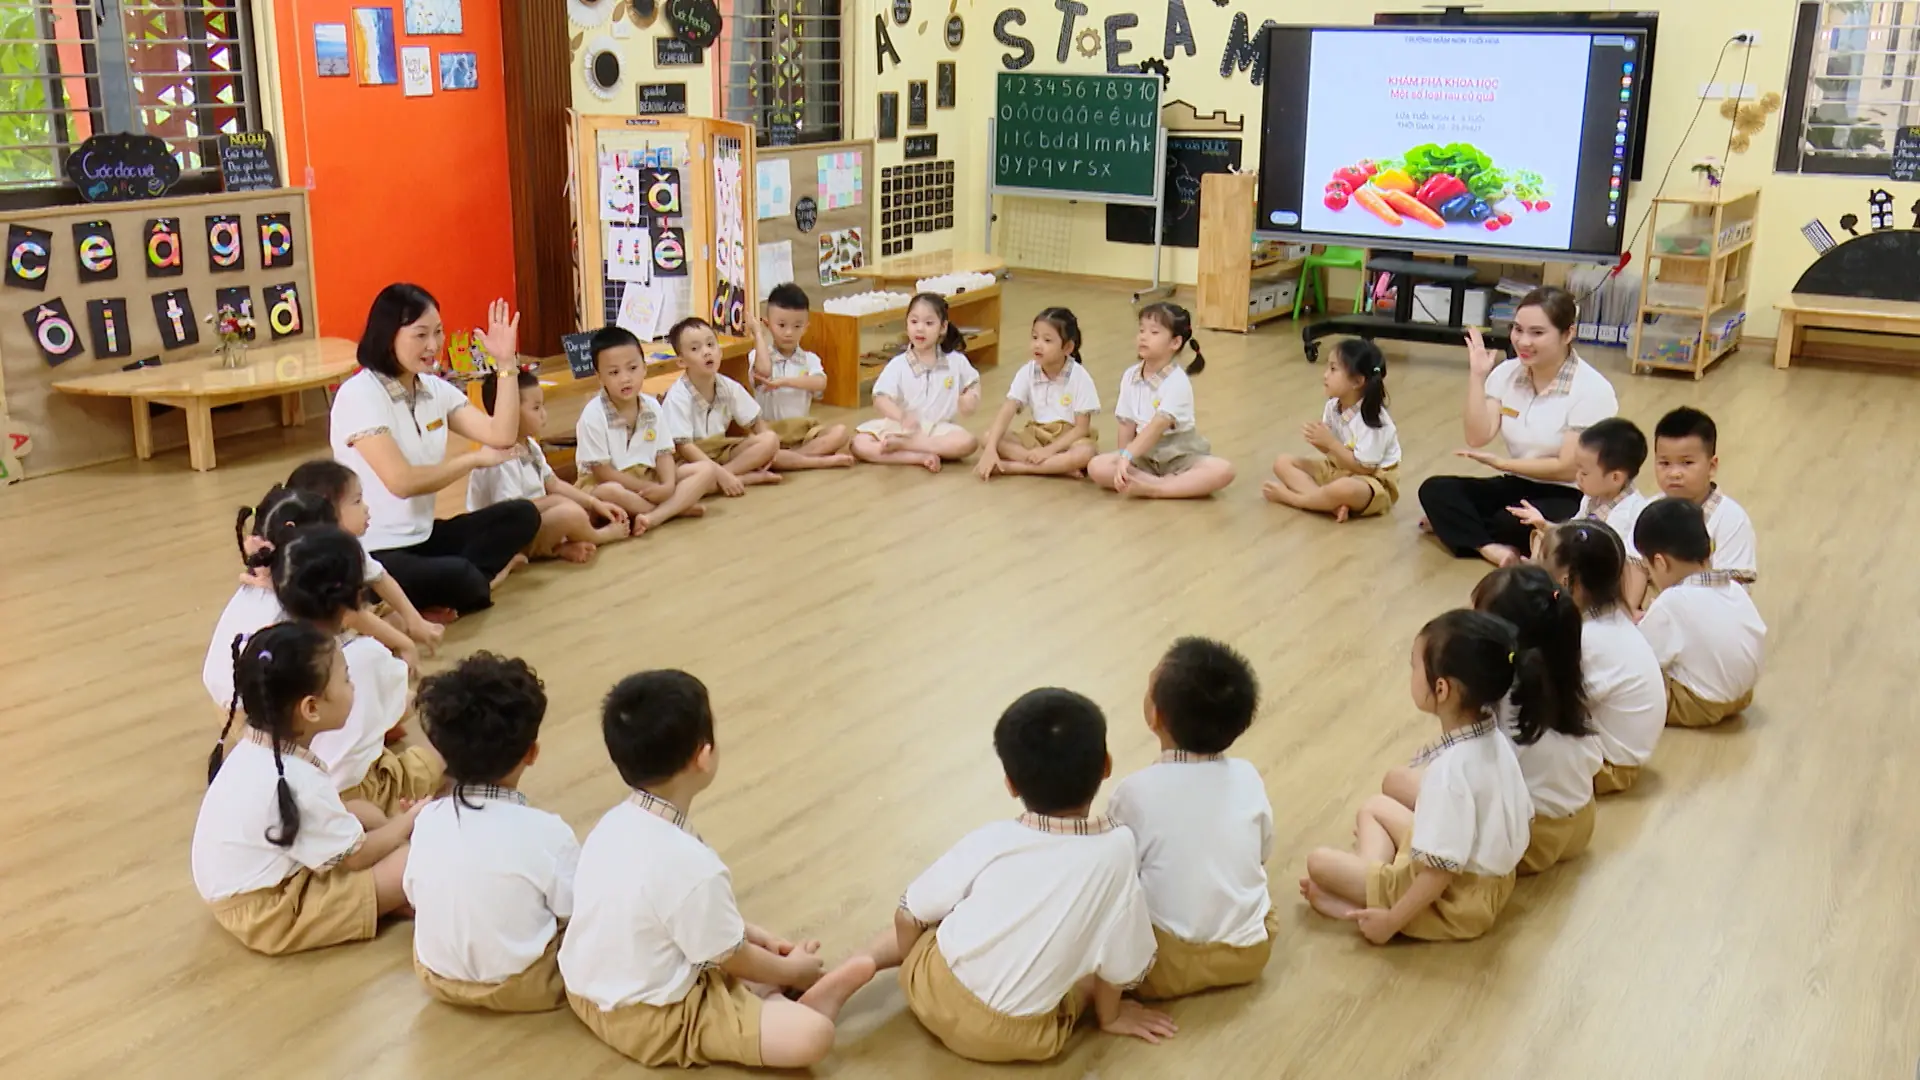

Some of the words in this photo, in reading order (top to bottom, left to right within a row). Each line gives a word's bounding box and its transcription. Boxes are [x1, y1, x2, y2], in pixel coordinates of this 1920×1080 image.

[1005, 77, 1012, 93] 1
[1018, 77, 1027, 95] 2
[1033, 78, 1043, 96] 3
[1046, 80, 1055, 96] 4
[1062, 79, 1072, 97] 5
[1076, 80, 1086, 98] 6
[1092, 82, 1100, 98] 7
[1106, 81, 1118, 100] 8
[1123, 82, 1133, 100] 9
[1139, 82, 1157, 102] 10
[1388, 76, 1418, 86] KHÁM
[1421, 77, 1443, 88] PHÁ
[1445, 79, 1474, 89] KHOA
[1477, 79, 1499, 90] HỌC
[1391, 89, 1409, 100] Một
[1094, 108, 1104, 125] e
[1109, 105, 1120, 126] ê
[1039, 131, 1050, 149] b
[1052, 131, 1064, 150] d
[1095, 136, 1110, 152] m
[1115, 137, 1127, 152] n
[1130, 133, 1140, 154] h
[1143, 135, 1152, 152] k
[1000, 154, 1010, 175] g
[1015, 156, 1023, 174] y
[1027, 157, 1038, 176] p
[1042, 157, 1052, 177] q
[1058, 160, 1067, 172] v
[1073, 158, 1084, 174] r
[1088, 160, 1097, 177] s
[1101, 162, 1112, 177] x
[648, 171, 680, 213] ă
[11, 240, 47, 279] c
[80, 234, 113, 272] e
[148, 222, 180, 268] â
[210, 221, 240, 266] g
[261, 222, 290, 266] p
[655, 230, 685, 271] ê
[36, 305, 75, 354] ô
[103, 309, 118, 352] i
[167, 298, 185, 342] t
